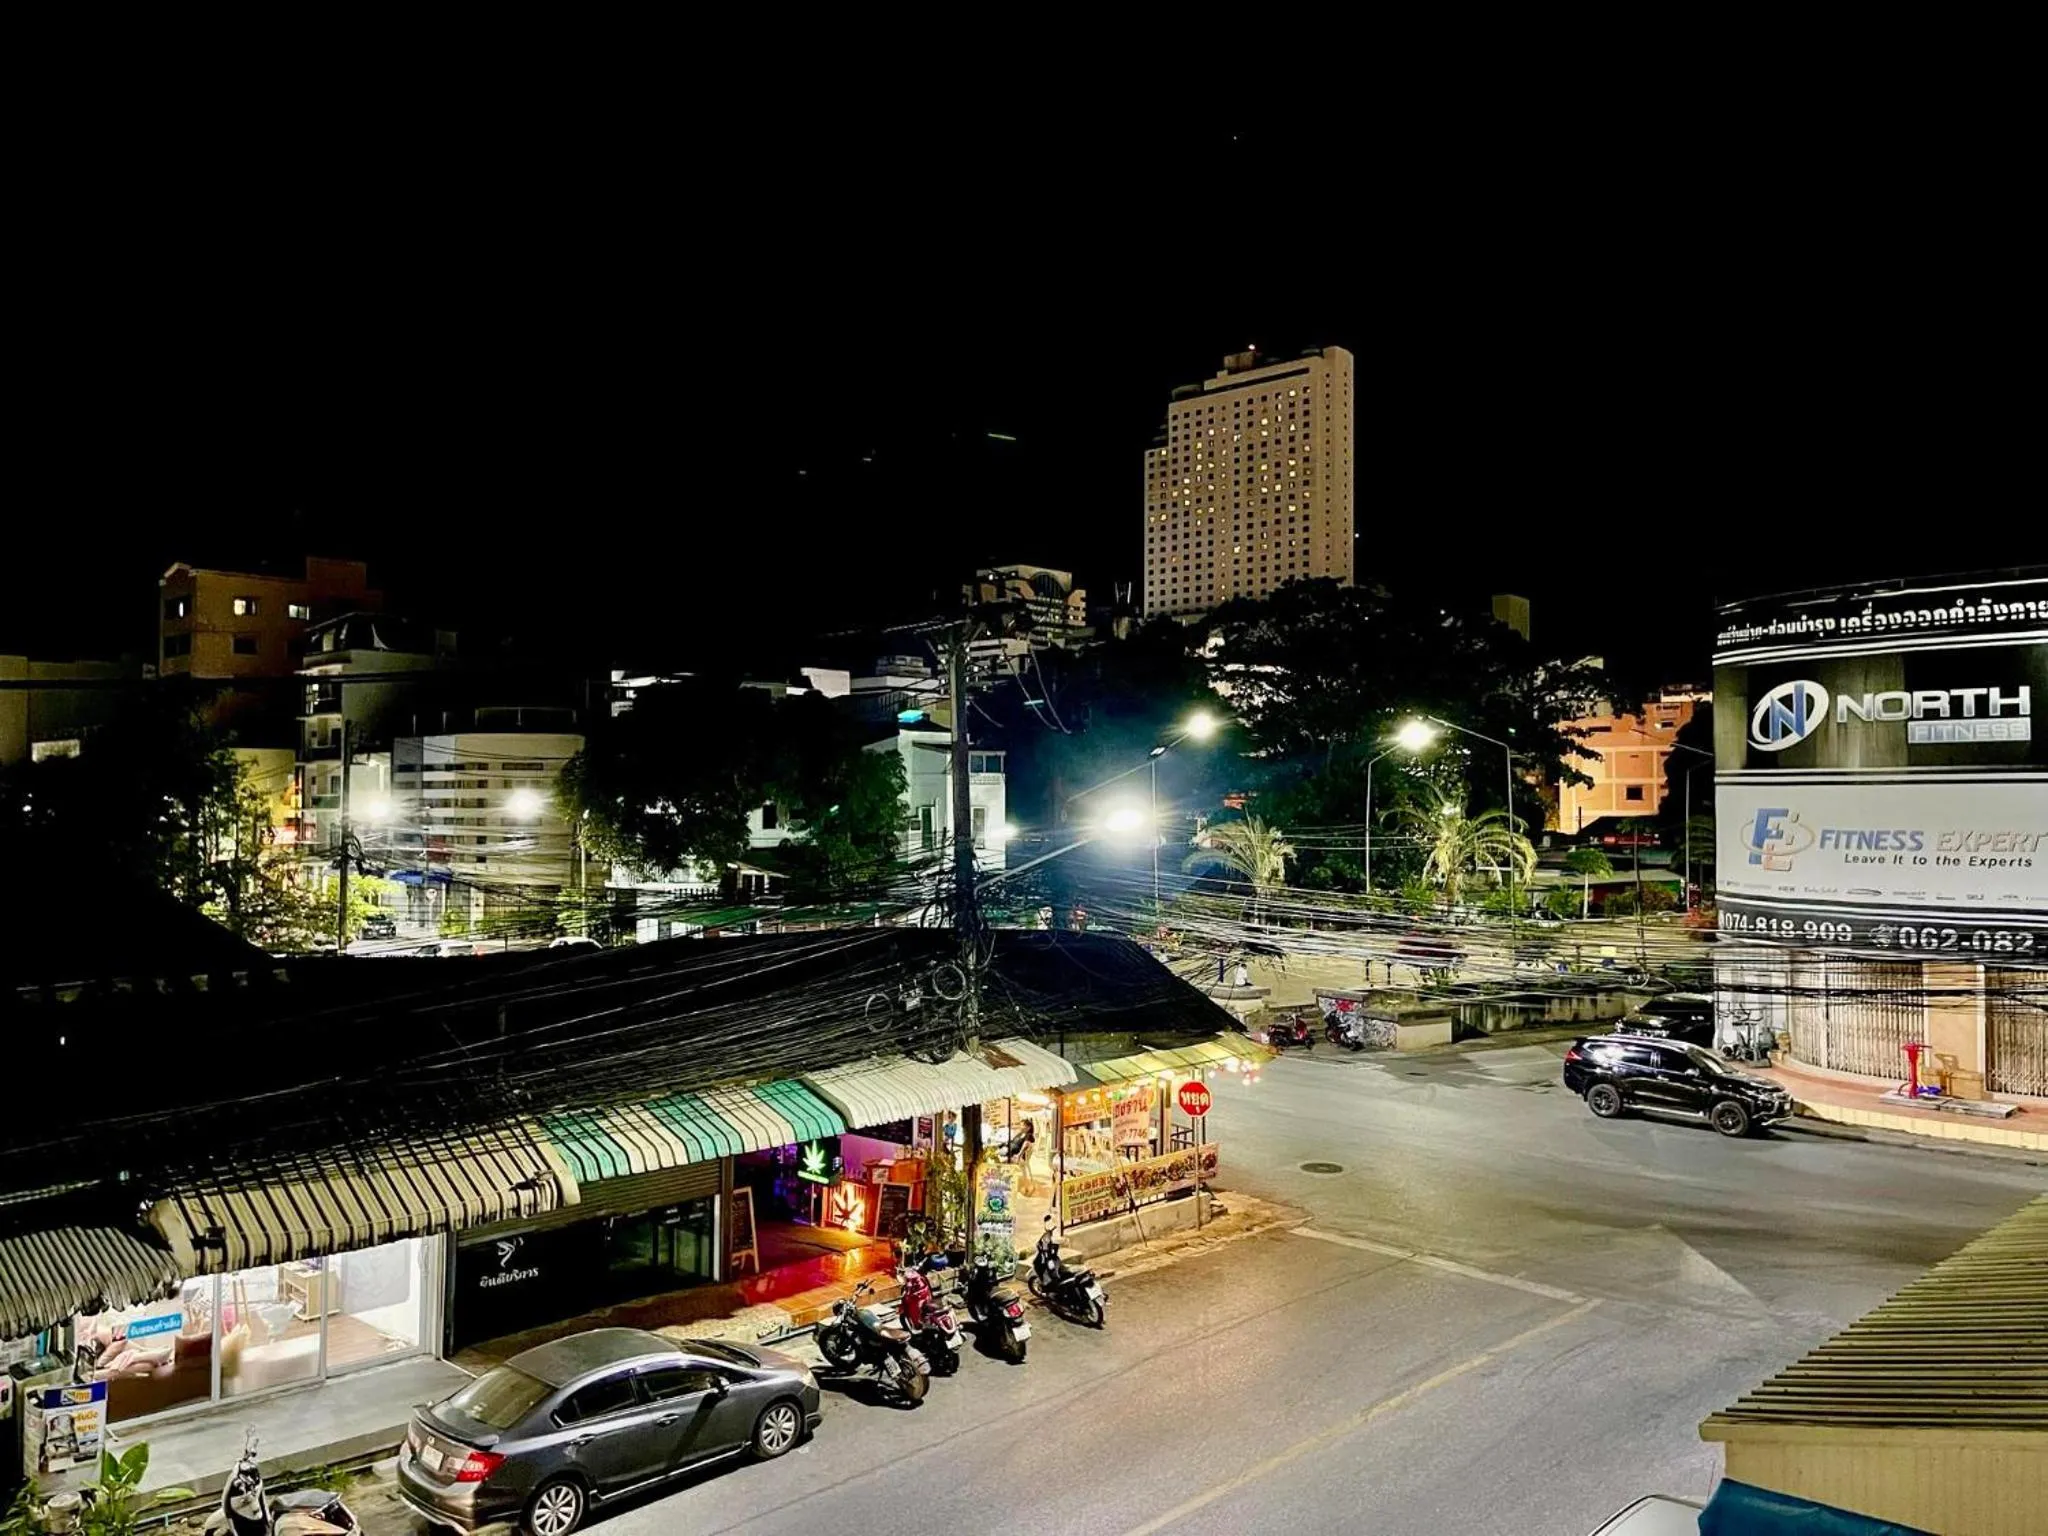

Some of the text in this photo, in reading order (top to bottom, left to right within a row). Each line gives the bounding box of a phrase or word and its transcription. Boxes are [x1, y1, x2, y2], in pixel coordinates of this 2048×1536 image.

[1836, 685, 2032, 723] NORTH
[1914, 722, 2027, 742] FITNESS
[1819, 829, 2048, 854] FITNESS EXPERT
[1844, 852, 2033, 869] Leave It to the Experts
[1180, 1091, 1209, 1114] หยุด
